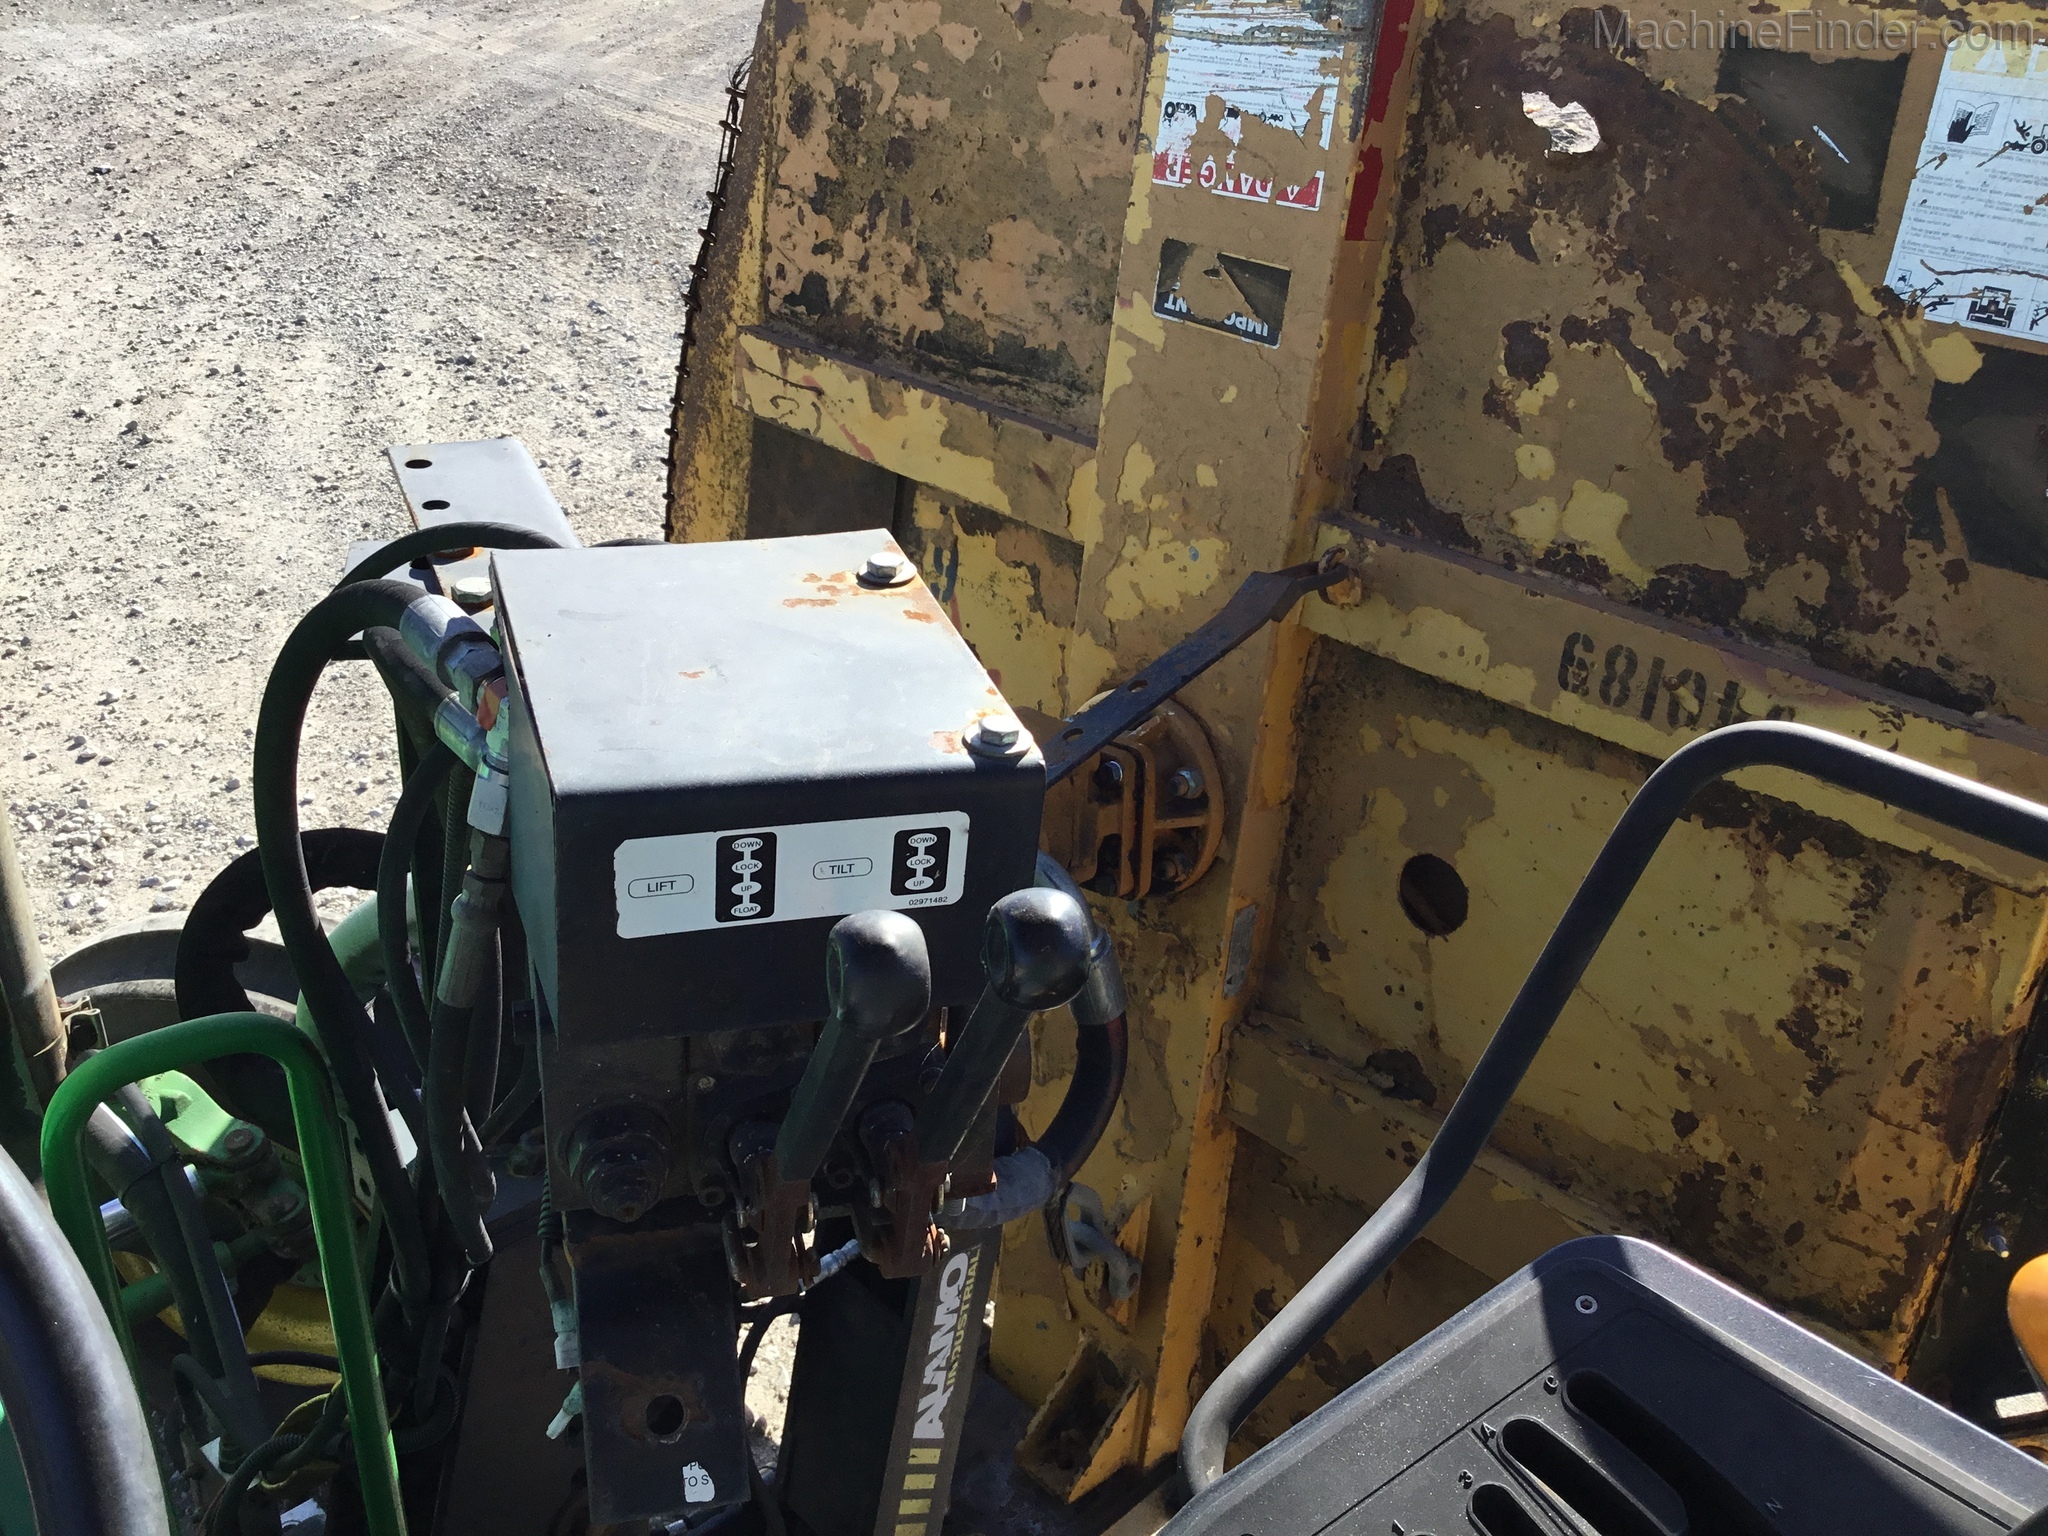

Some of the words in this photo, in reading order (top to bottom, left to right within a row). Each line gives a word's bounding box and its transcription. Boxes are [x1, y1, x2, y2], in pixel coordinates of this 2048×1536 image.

[733, 840, 762, 849] DOWN
[909, 836, 936, 845] DOWN
[735, 862, 760, 871] LOCK
[910, 858, 932, 866] LOCK
[829, 863, 855, 875] TILT
[647, 880, 677, 893] LIFT
[913, 879, 925, 887] UP
[740, 884, 753, 893] UP
[908, 896, 948, 906] 02971482
[733, 905, 759, 914] FLOAT
[912, 1252, 969, 1439] ALAMO
